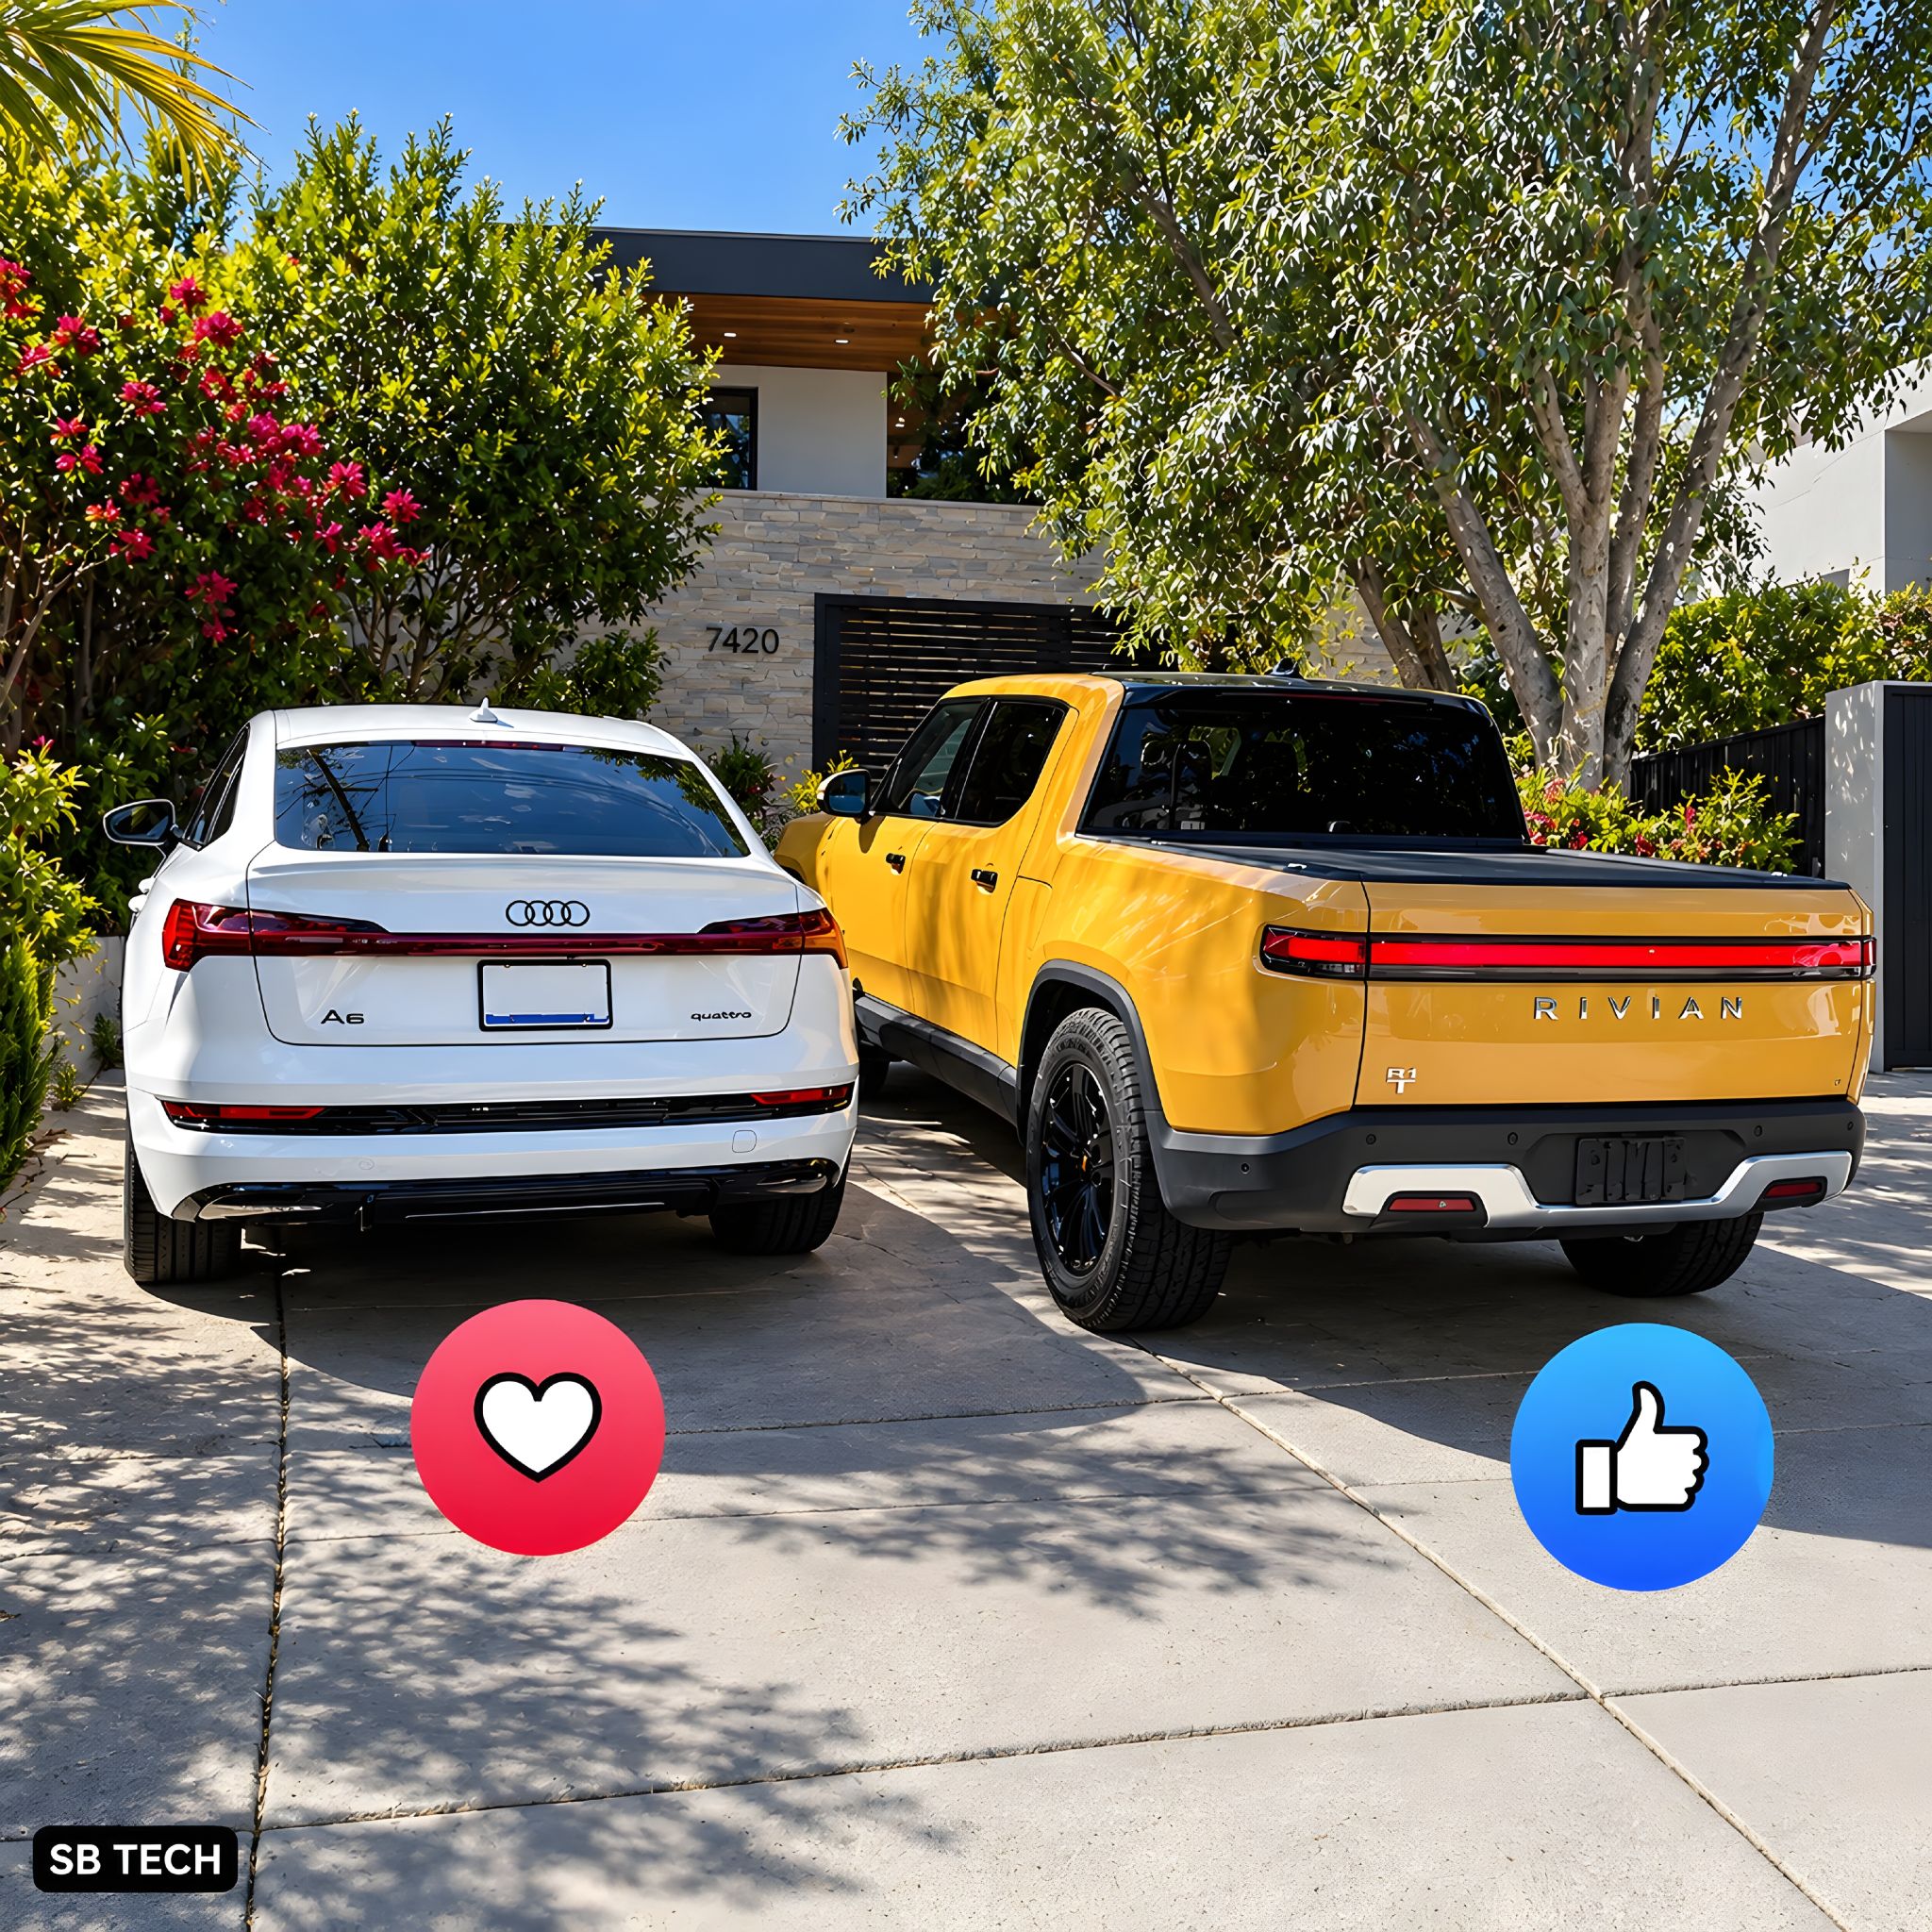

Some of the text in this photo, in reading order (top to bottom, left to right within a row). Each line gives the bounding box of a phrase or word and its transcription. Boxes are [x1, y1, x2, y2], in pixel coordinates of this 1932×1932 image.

[706, 626, 780, 655] 7420
[321, 1008, 365, 1024] A6
[691, 1011, 753, 1022] quattro
[1533, 996, 1743, 1021] RIVIAN
